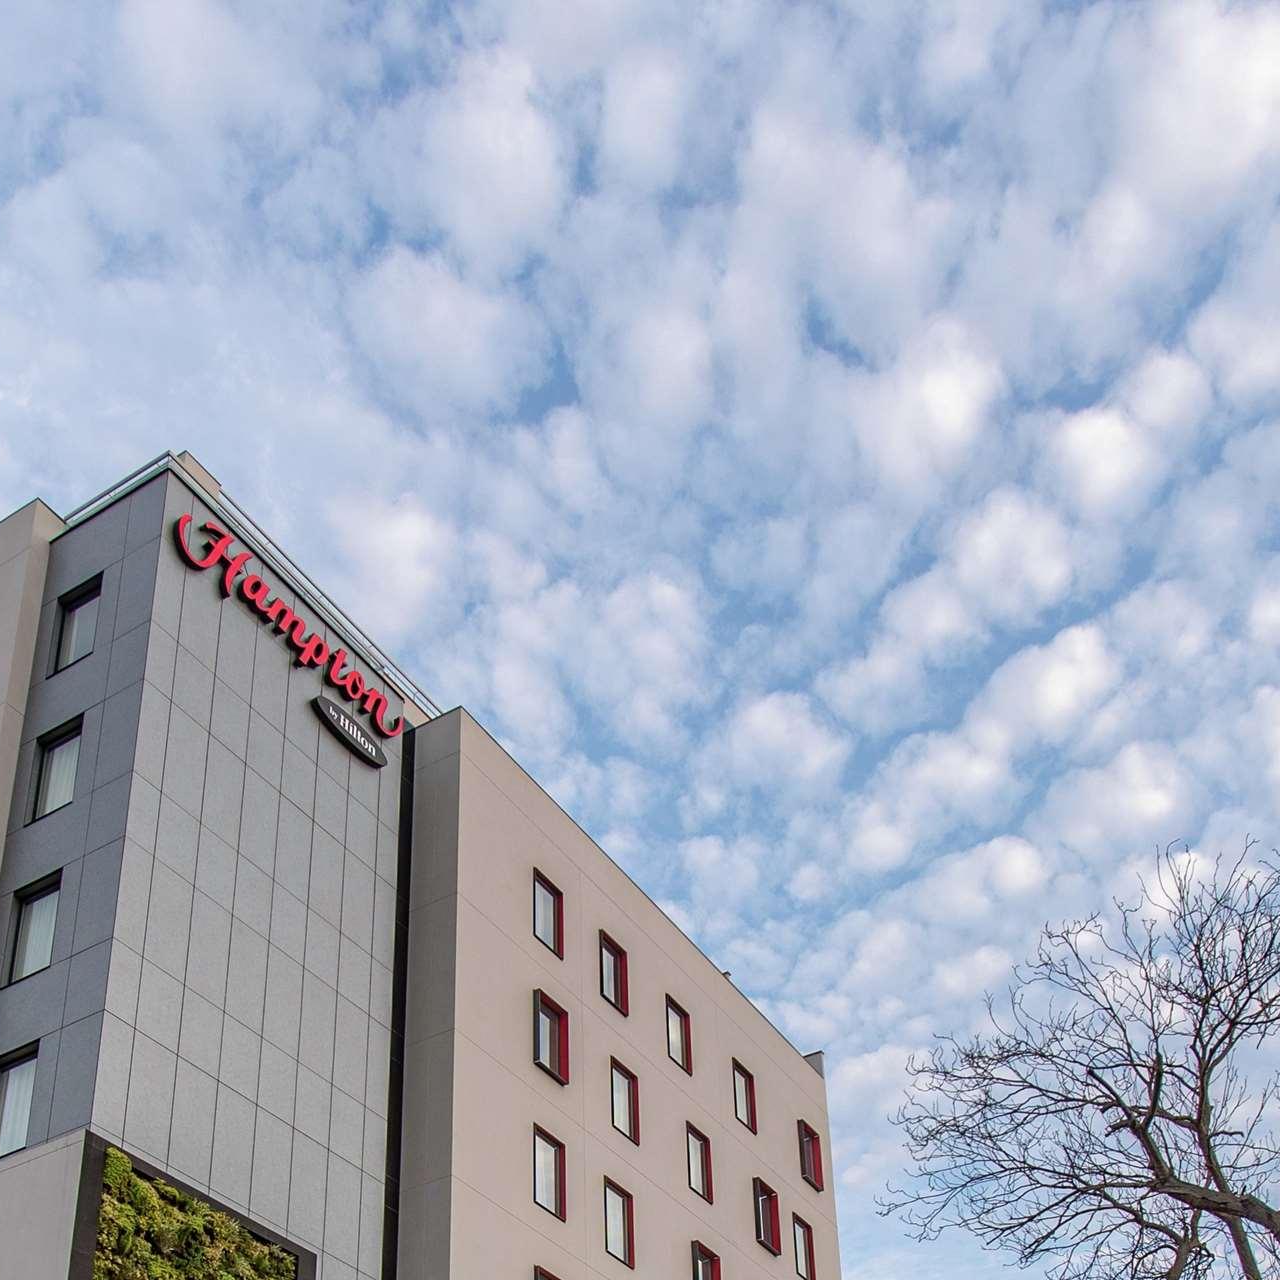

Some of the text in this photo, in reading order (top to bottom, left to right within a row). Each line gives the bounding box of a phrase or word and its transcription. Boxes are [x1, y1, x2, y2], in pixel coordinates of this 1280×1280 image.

[175, 513, 404, 738] Hampton
[329, 706, 376, 757] by Hilton
